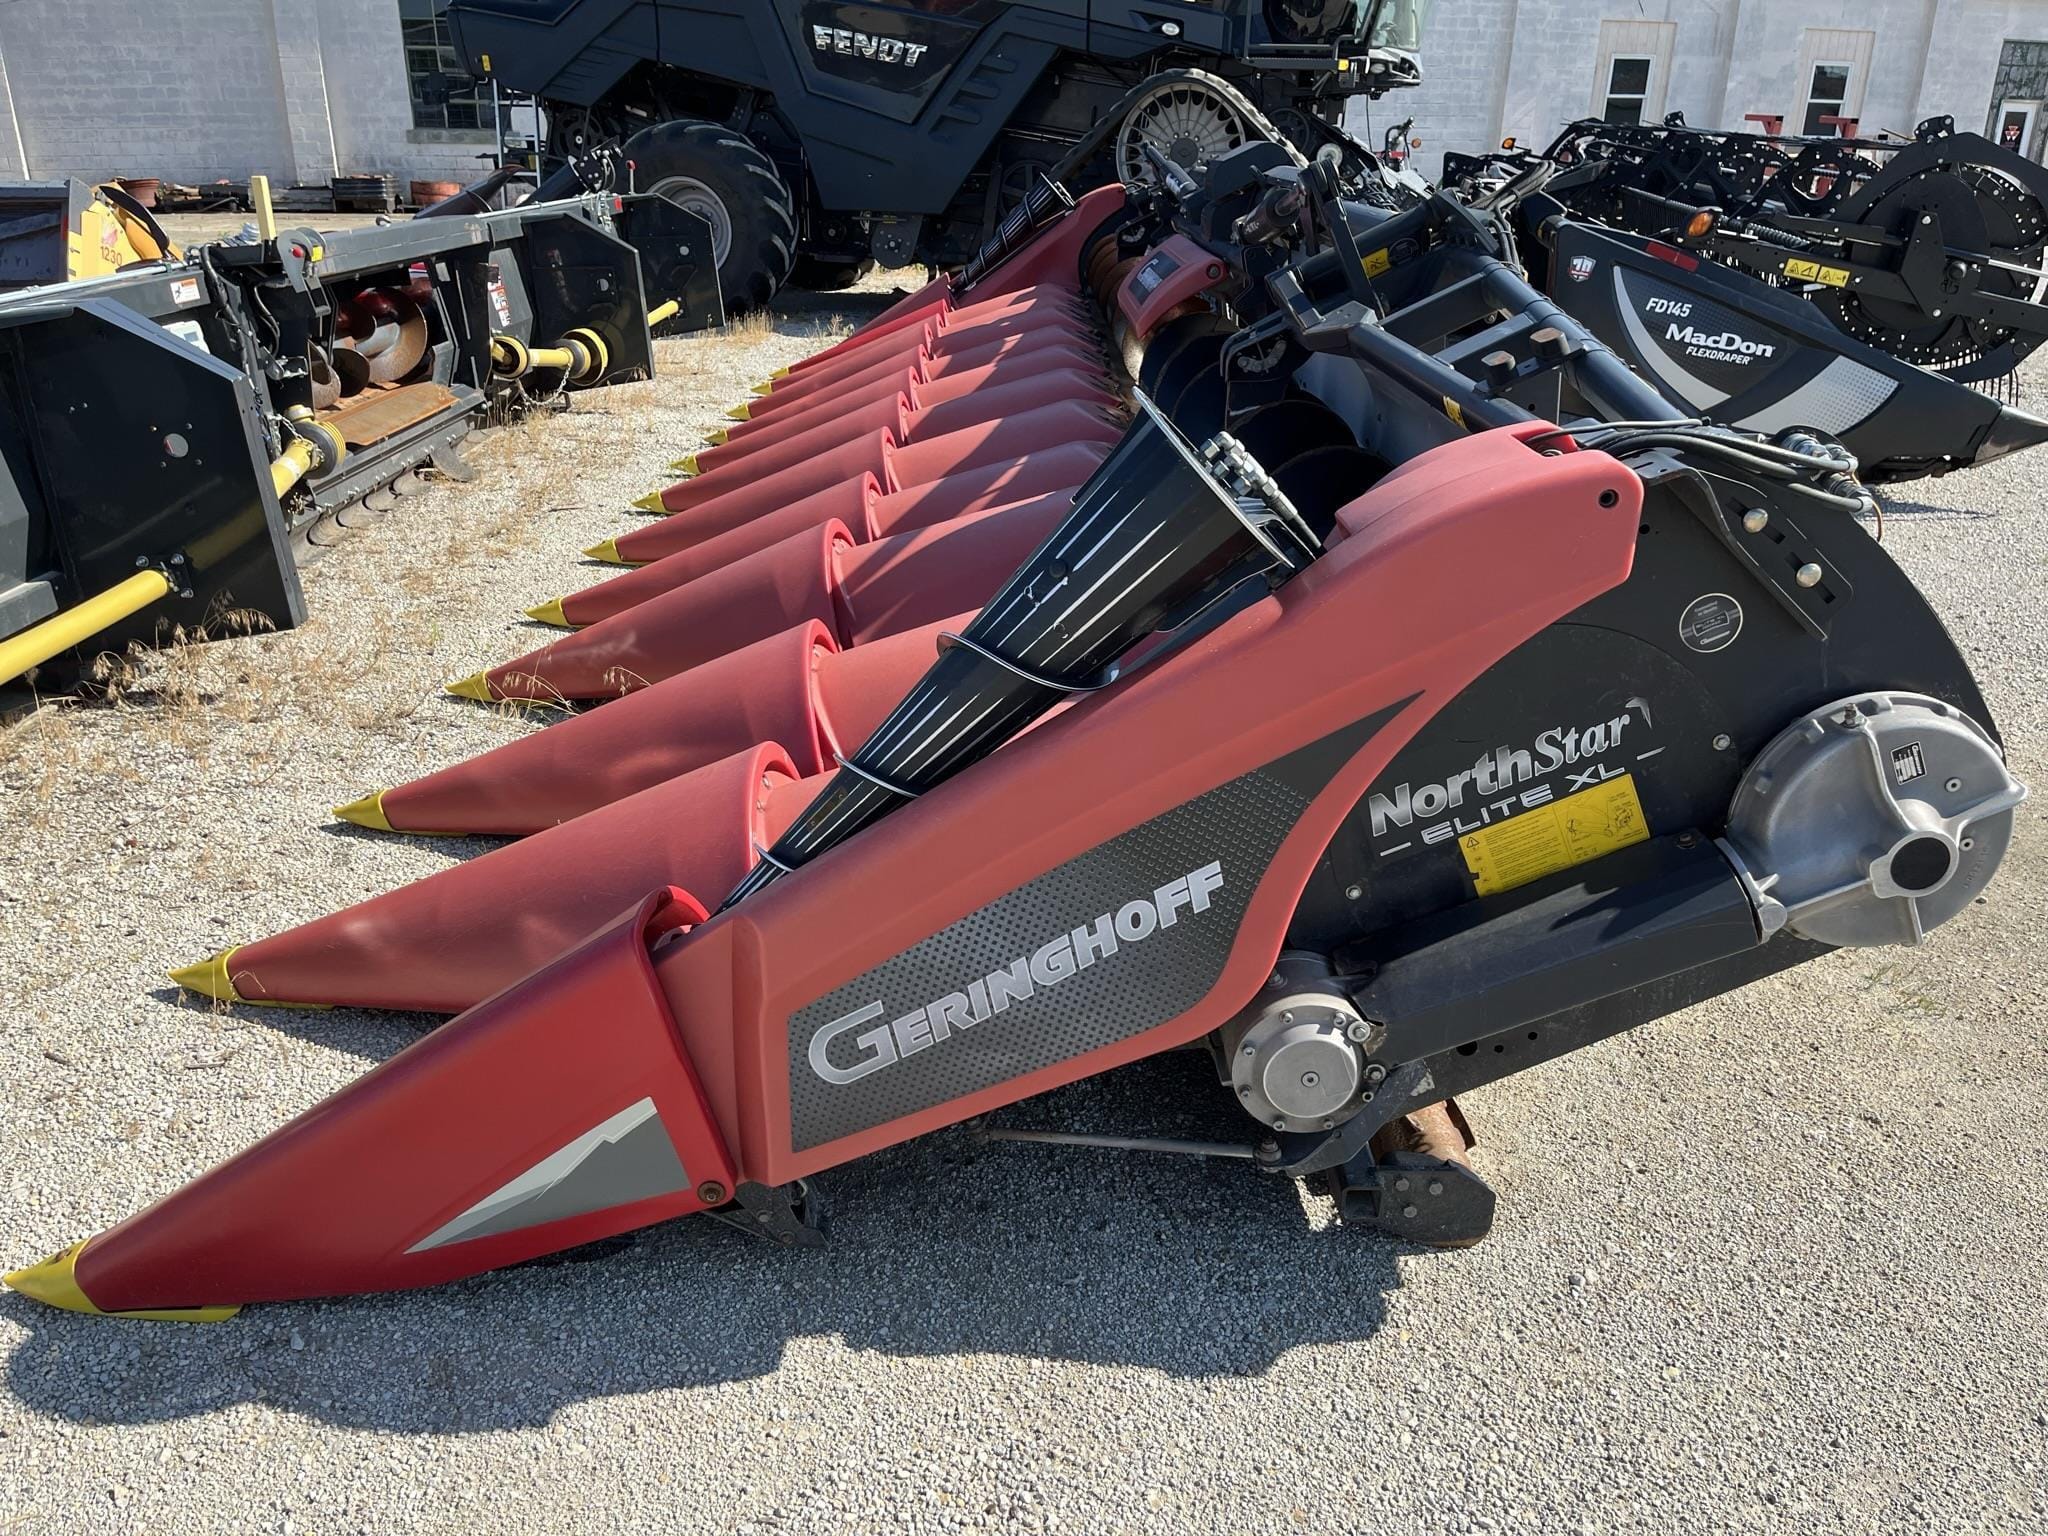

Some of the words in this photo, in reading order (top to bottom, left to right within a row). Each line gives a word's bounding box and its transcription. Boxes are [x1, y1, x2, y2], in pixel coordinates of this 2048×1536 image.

[813, 25, 928, 67] FENDT
[100, 246, 122, 266] 1230
[1645, 298, 1692, 317] FD145
[1665, 323, 1775, 358] MacDon
[1686, 346, 1751, 365] FLEXDRAPER
[1368, 714, 1630, 837] NorthStar
[1421, 783, 1553, 845] ELITE
[1565, 763, 1626, 792] XL
[808, 860, 1224, 1085] GERINGHOFF
